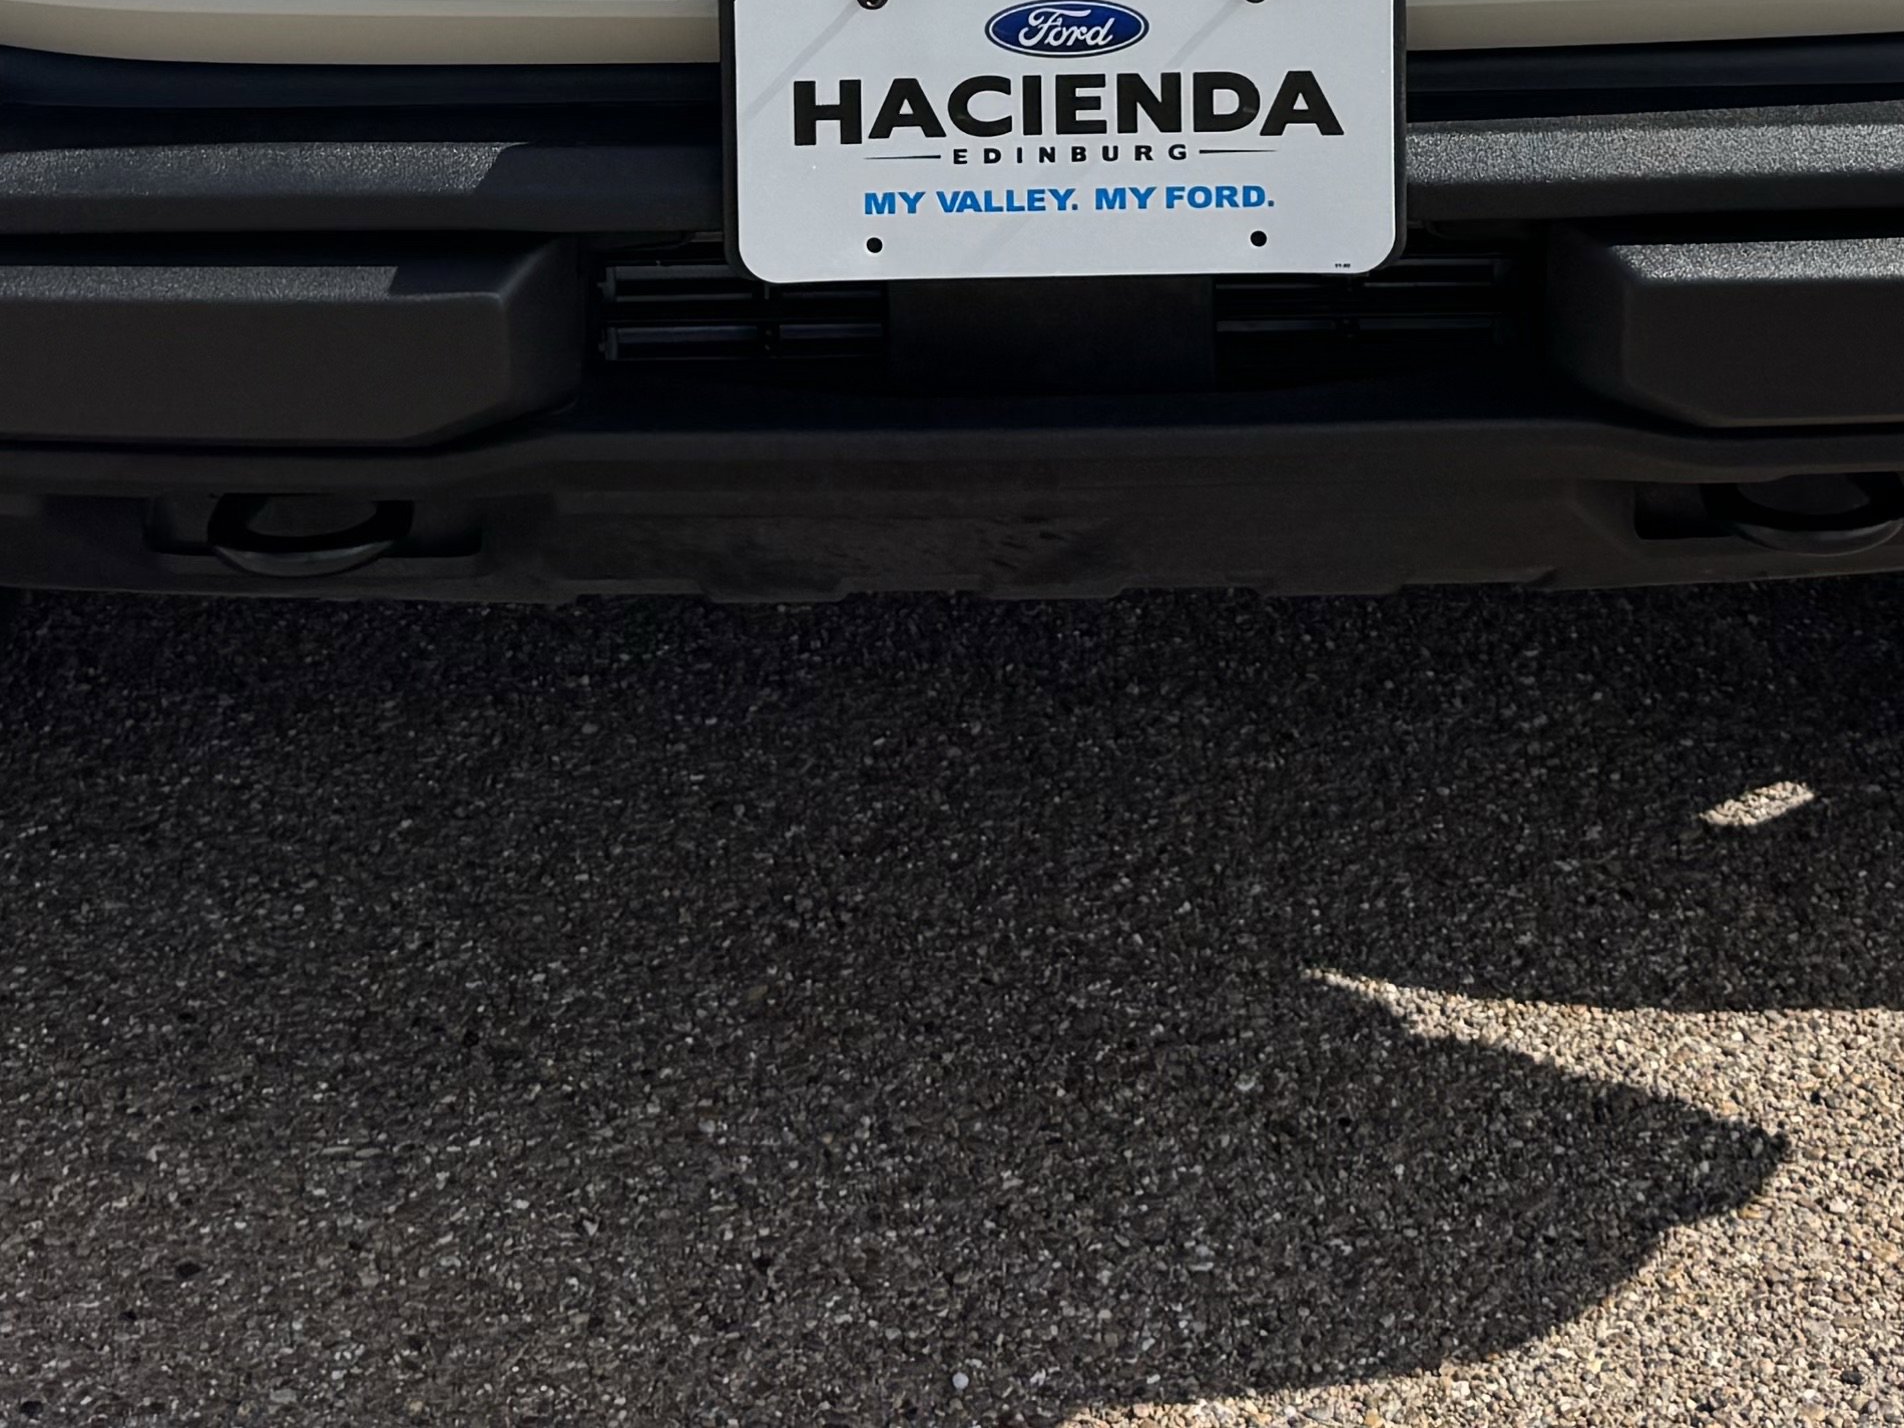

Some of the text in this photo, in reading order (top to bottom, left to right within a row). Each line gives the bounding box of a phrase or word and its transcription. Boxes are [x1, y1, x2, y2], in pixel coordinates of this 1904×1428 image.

[1018, 8, 1116, 47] Ford
[793, 70, 1345, 146] HACIENDA
[953, 143, 1187, 165] EDINBURG
[864, 185, 1275, 215] MY VALLEY. MY FORD.
